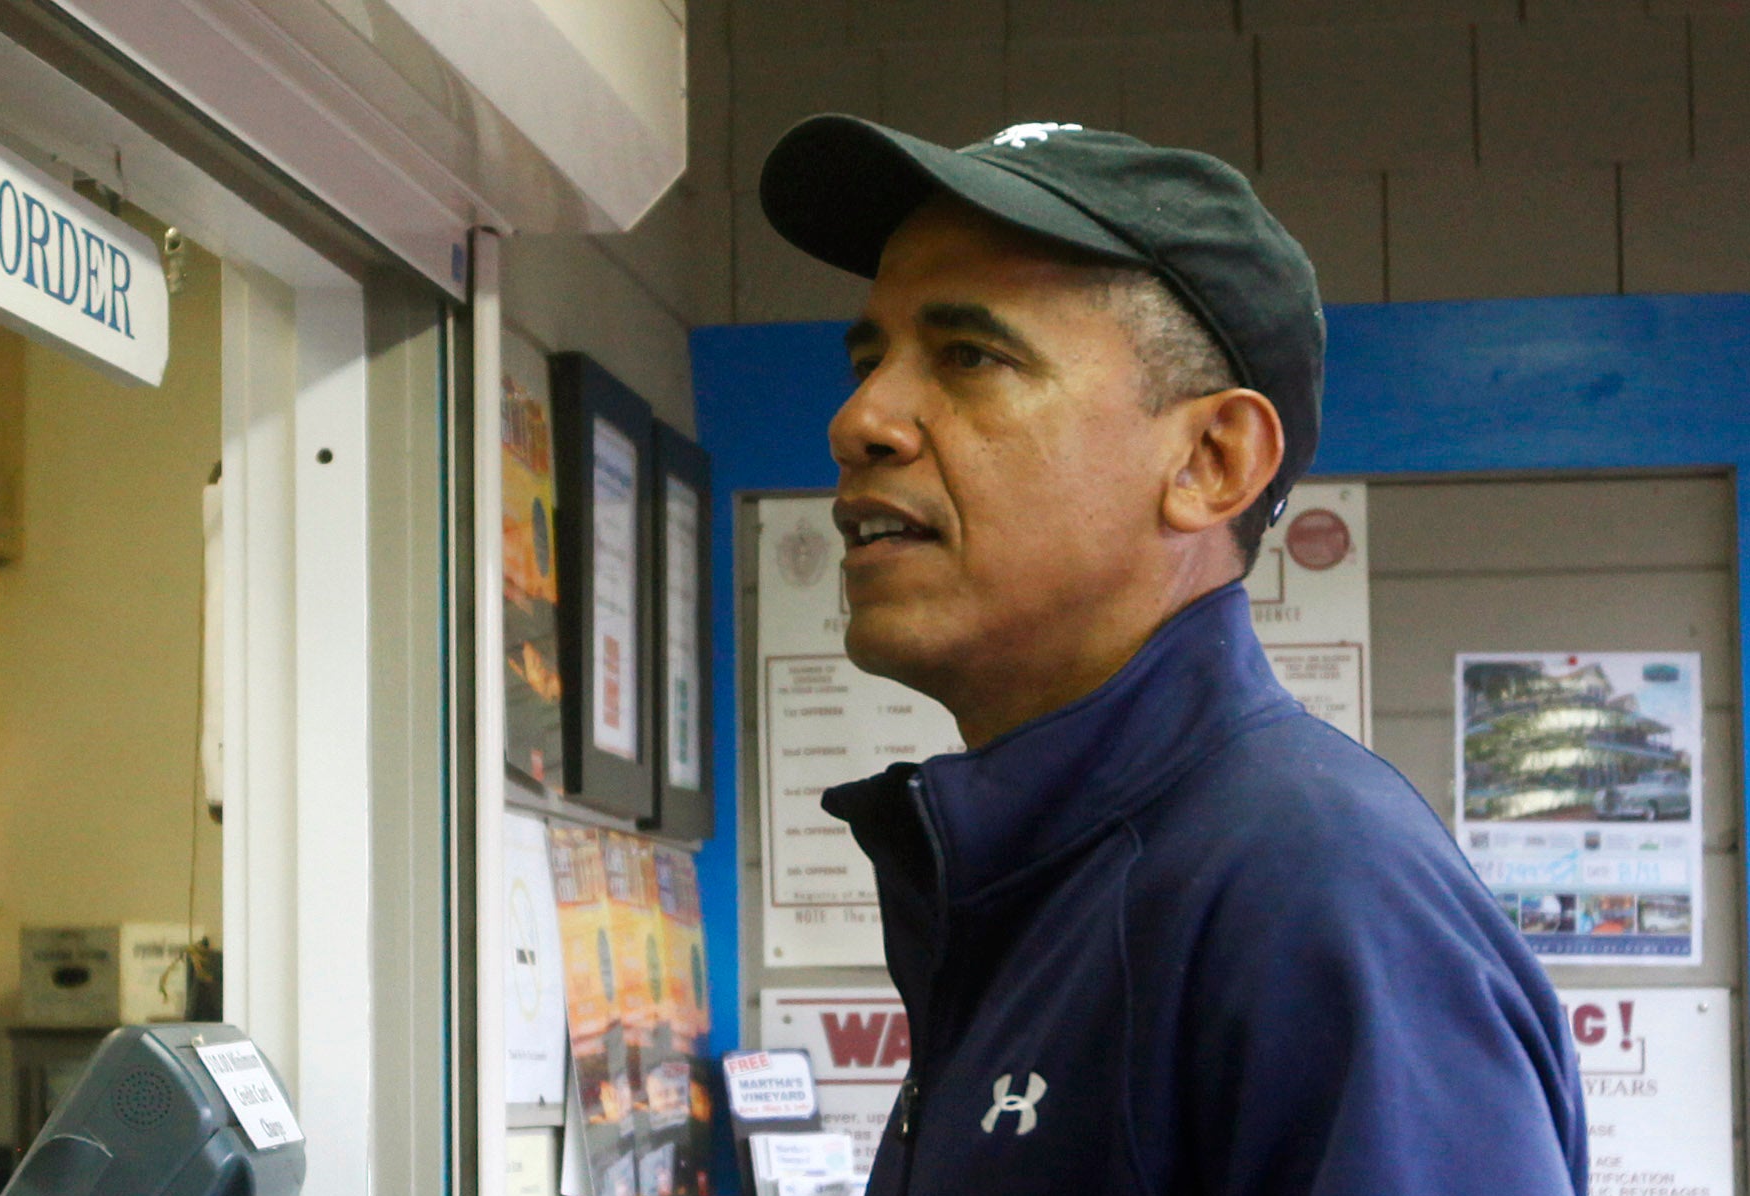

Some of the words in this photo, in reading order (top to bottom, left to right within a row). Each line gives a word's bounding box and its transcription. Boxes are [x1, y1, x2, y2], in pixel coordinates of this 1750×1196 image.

[820, 1011, 912, 1068] WA
[727, 1052, 771, 1075] FREE
[738, 1077, 804, 1091] MARTHA'S
[1585, 1078, 1659, 1098] YEARS
[740, 1090, 806, 1104] VINEYARD
